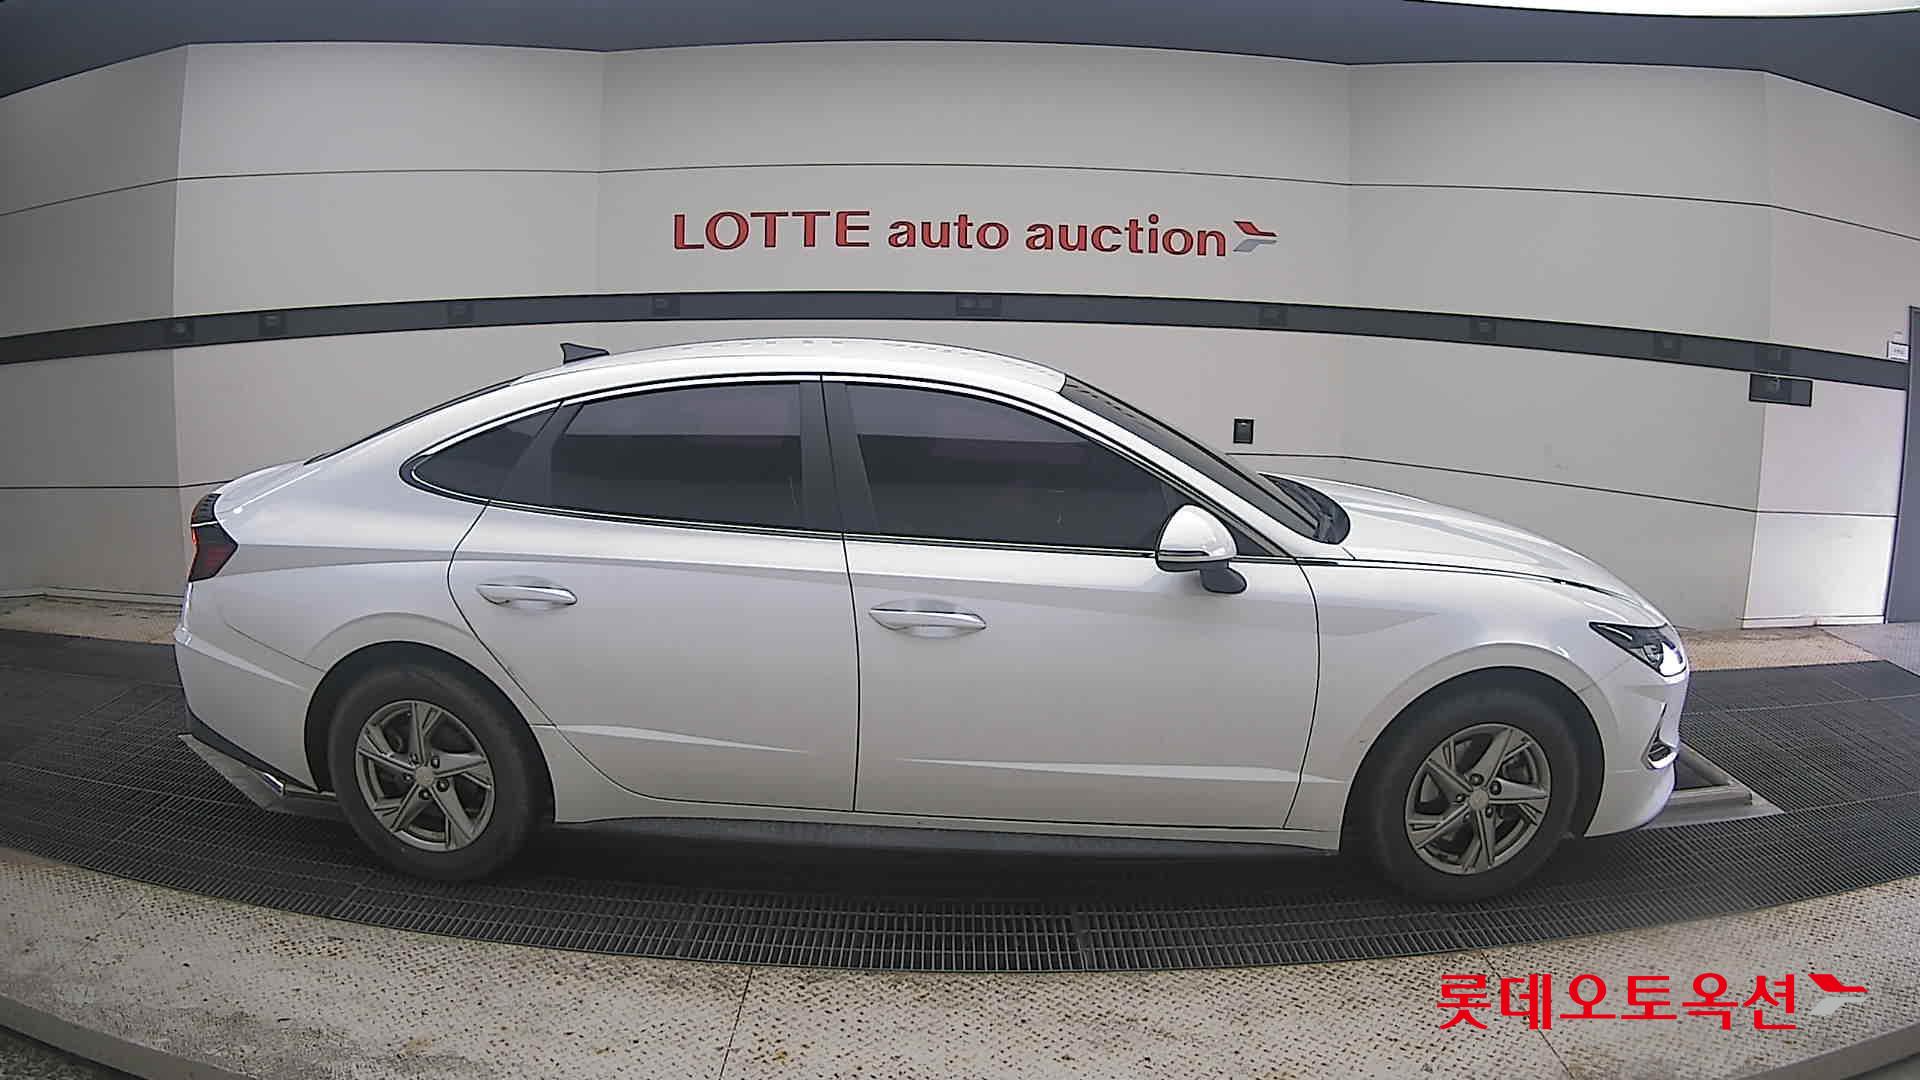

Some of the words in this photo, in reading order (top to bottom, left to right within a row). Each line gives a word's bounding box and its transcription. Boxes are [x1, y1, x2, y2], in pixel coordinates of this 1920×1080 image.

[673, 210, 871, 250] LOTTE
[887, 214, 1010, 250] auto
[1025, 213, 1228, 257] auction
